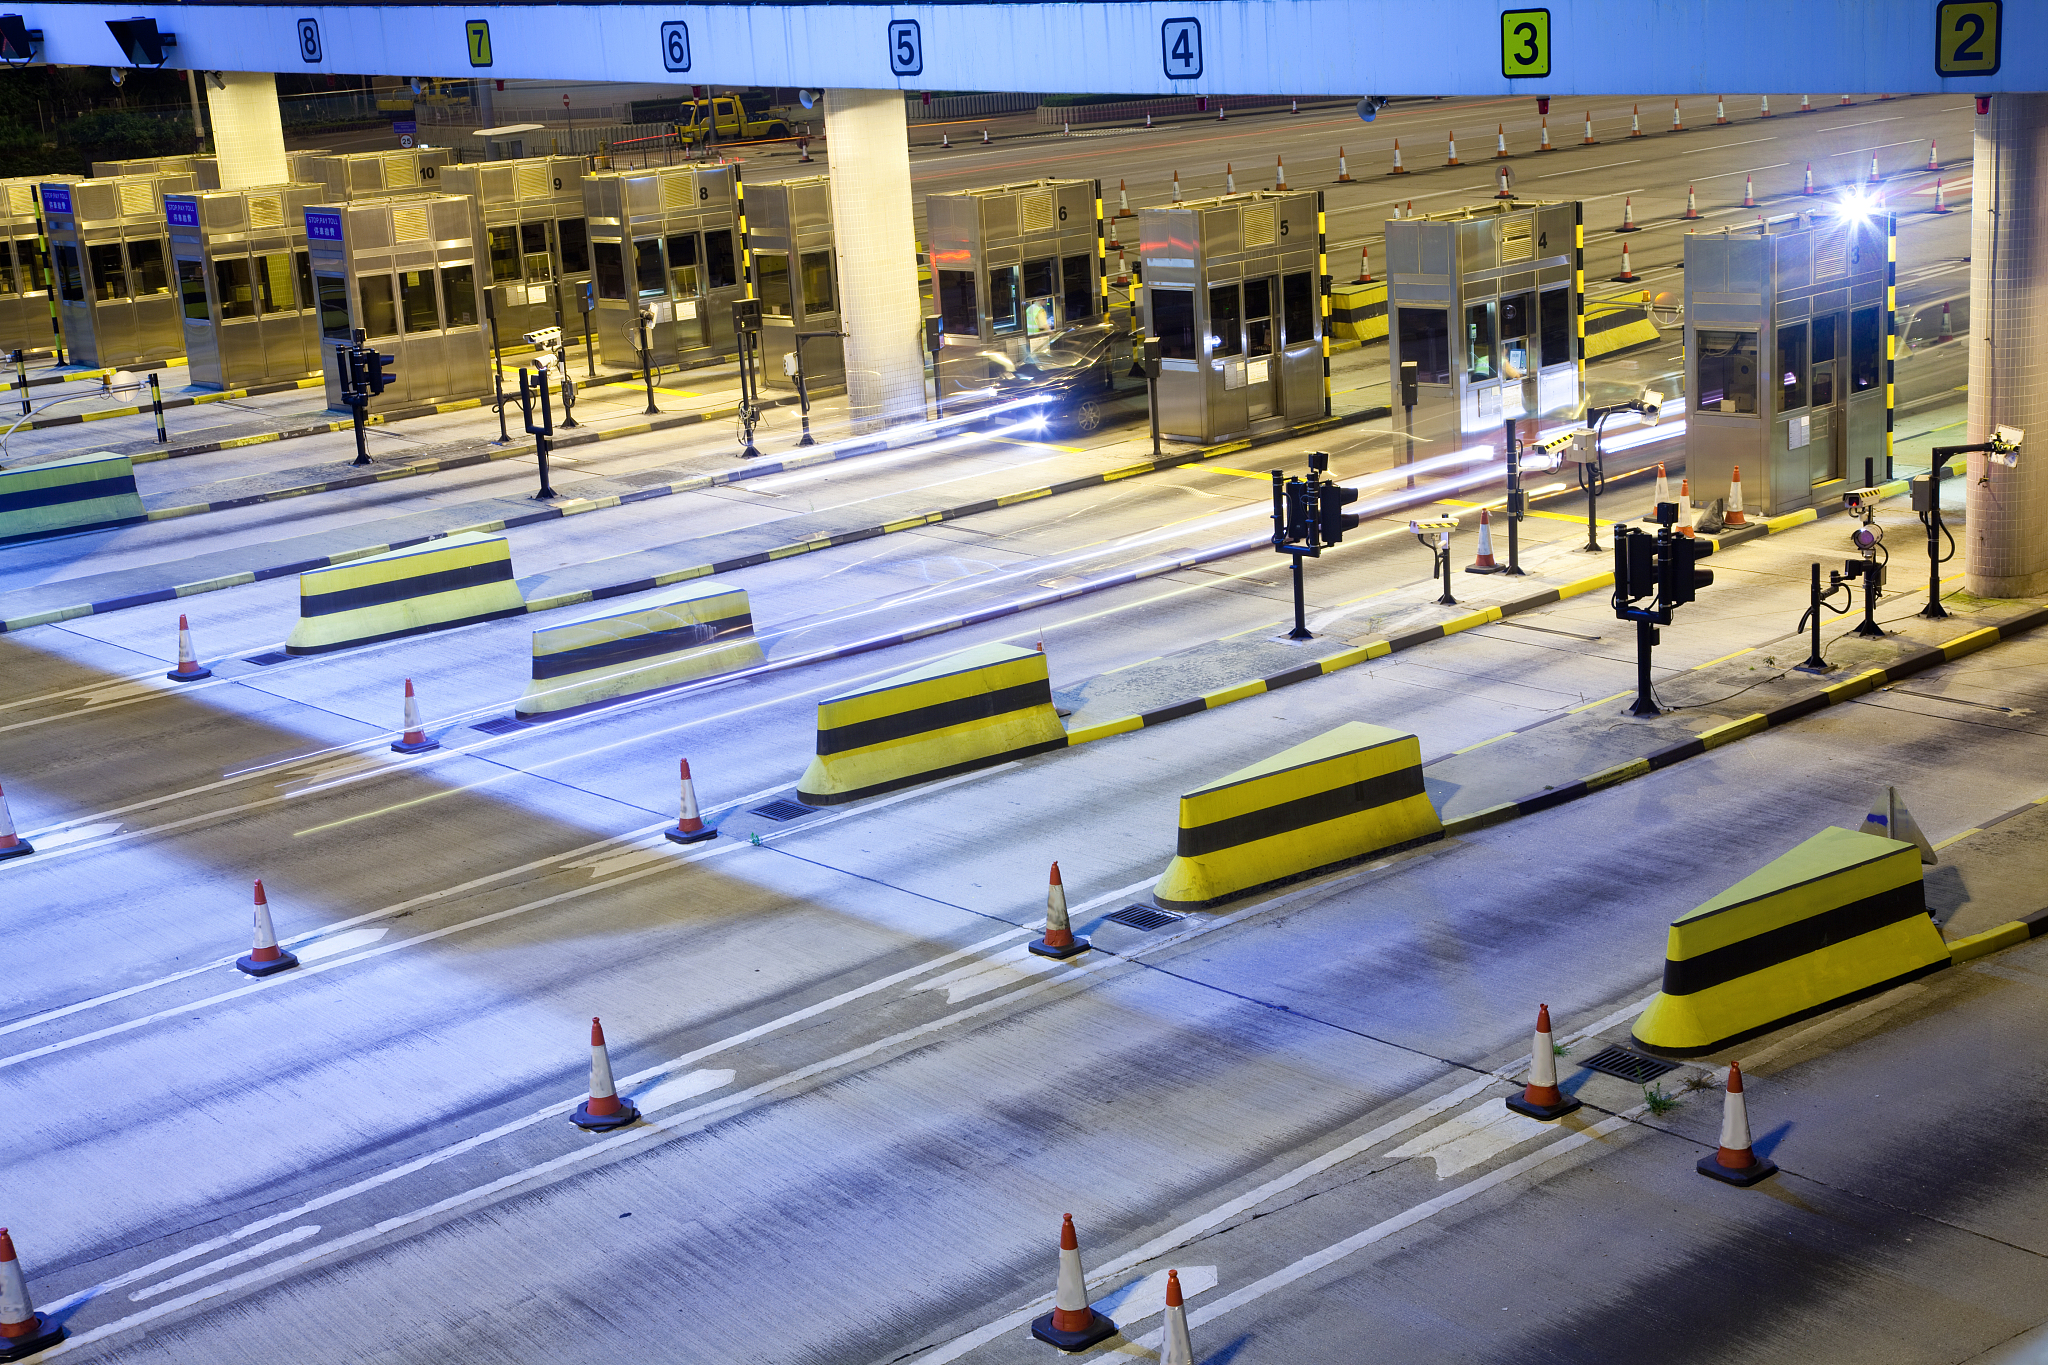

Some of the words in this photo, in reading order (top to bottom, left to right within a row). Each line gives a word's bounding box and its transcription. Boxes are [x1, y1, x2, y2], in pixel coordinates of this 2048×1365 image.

[303, 25, 317, 55] 8
[472, 29, 484, 57] 7
[668, 30, 684, 64] 6
[897, 30, 915, 66] 5
[1171, 28, 1194, 68] 4
[1513, 21, 1539, 66] 3
[1952, 12, 1985, 62] 2
[420, 166, 435, 180] 10
[553, 177, 562, 191] 9
[699, 186, 709, 201] 8
[1058, 205, 1068, 221] 6
[1280, 219, 1289, 236] 5
[1537, 231, 1548, 249] 4
[1851, 245, 1860, 265] 3
